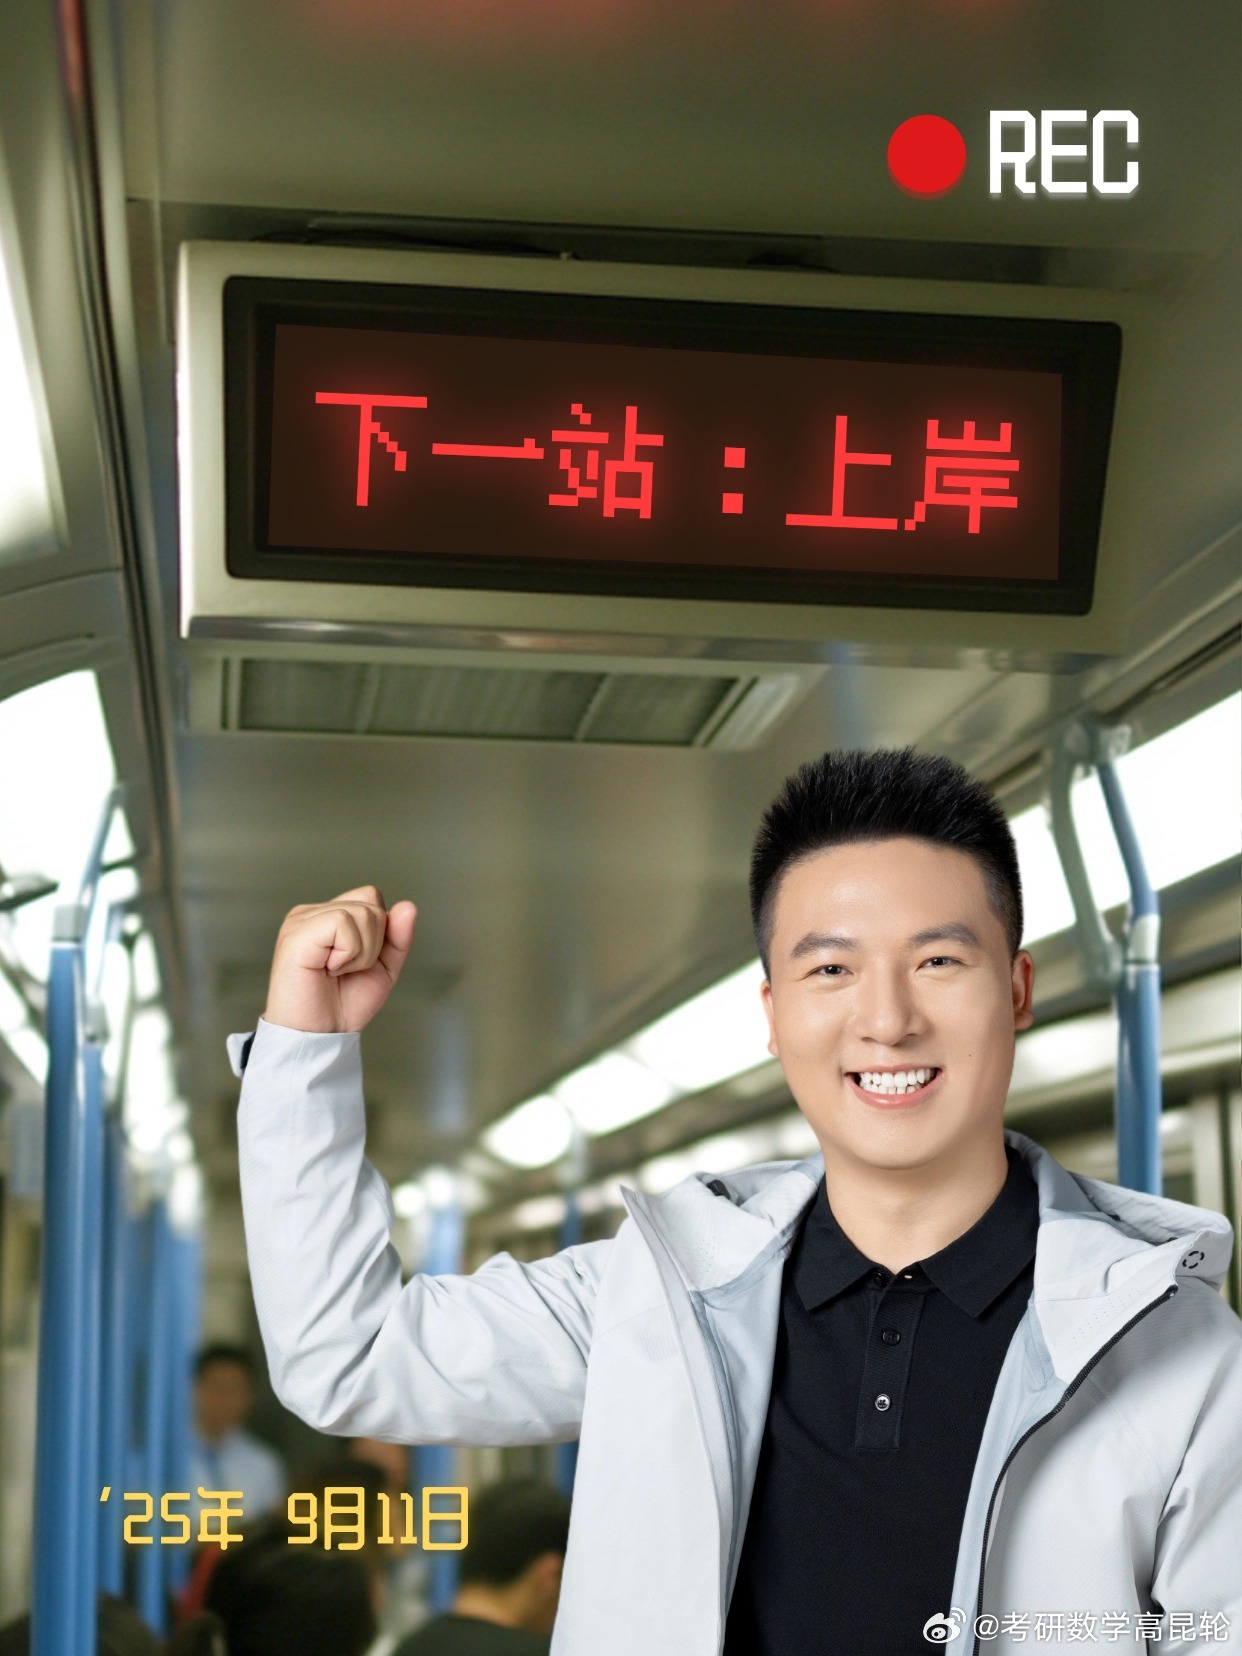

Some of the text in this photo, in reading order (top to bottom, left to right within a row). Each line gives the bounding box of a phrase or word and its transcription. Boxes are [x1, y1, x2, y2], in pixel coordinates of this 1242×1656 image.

[315, 391, 1020, 534] 下一站：上岸
